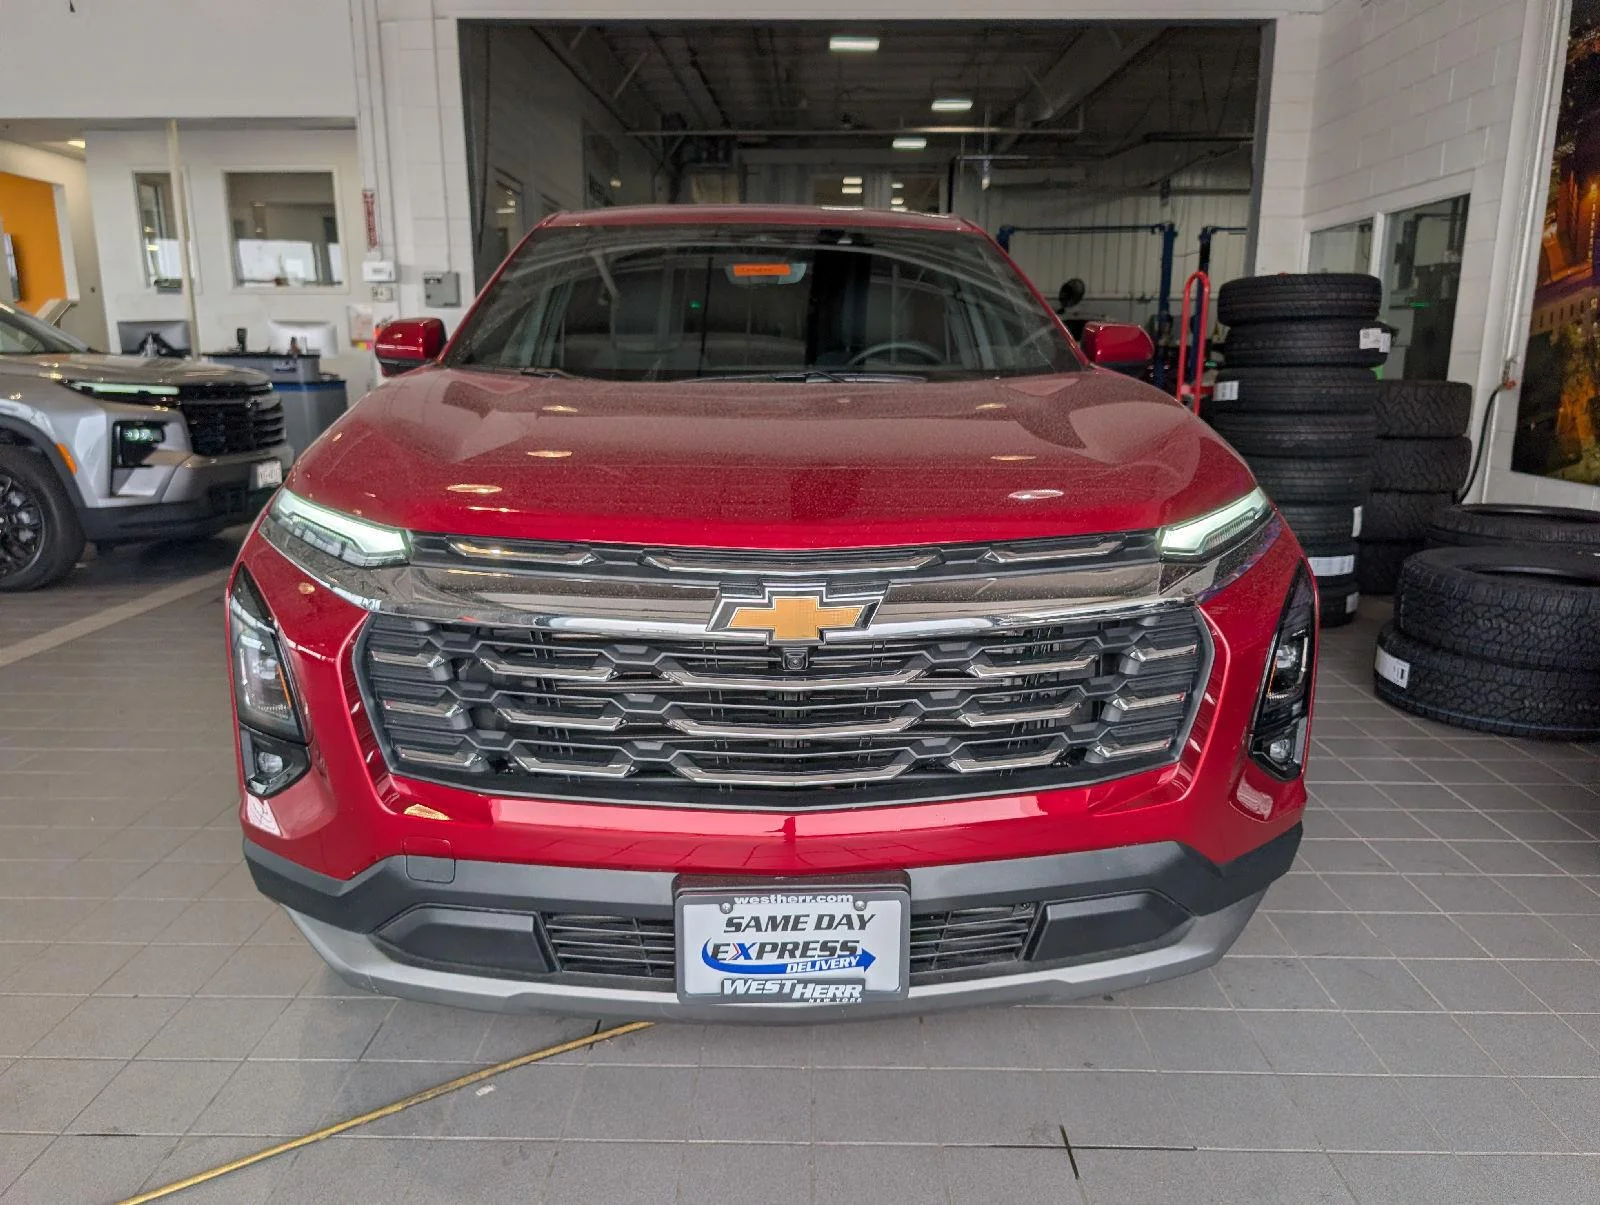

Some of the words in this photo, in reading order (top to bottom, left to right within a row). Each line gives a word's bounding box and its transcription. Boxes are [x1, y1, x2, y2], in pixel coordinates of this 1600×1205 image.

[733, 894, 854, 905] westherr.com
[723, 914, 810, 934] SAME
[813, 913, 876, 931] DAY
[710, 939, 860, 961] EXPRESS
[785, 955, 860, 974] DELIVERY
